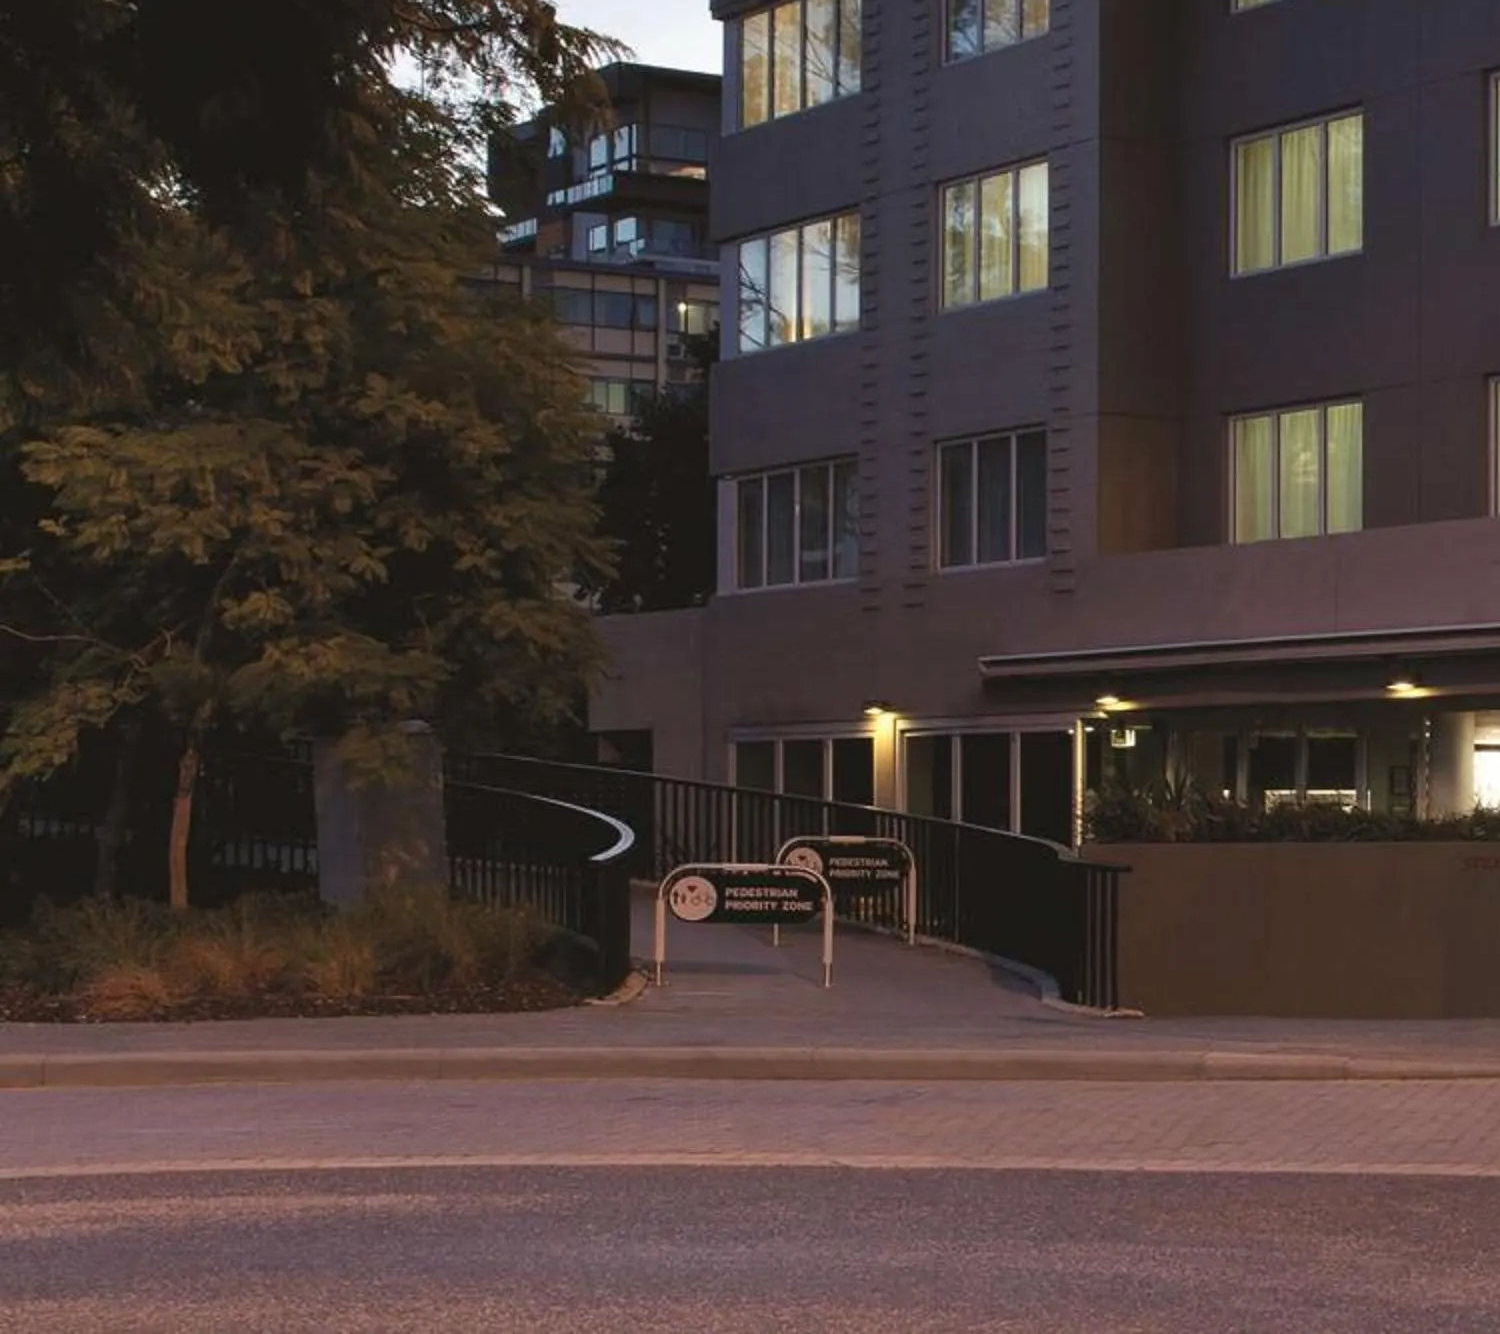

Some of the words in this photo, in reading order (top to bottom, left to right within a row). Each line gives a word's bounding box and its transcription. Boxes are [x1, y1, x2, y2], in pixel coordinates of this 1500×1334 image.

[724, 887, 799, 898] PEDESTRIAN
[724, 900, 779, 911] PRIORITY
[782, 900, 813, 911] ZONE
